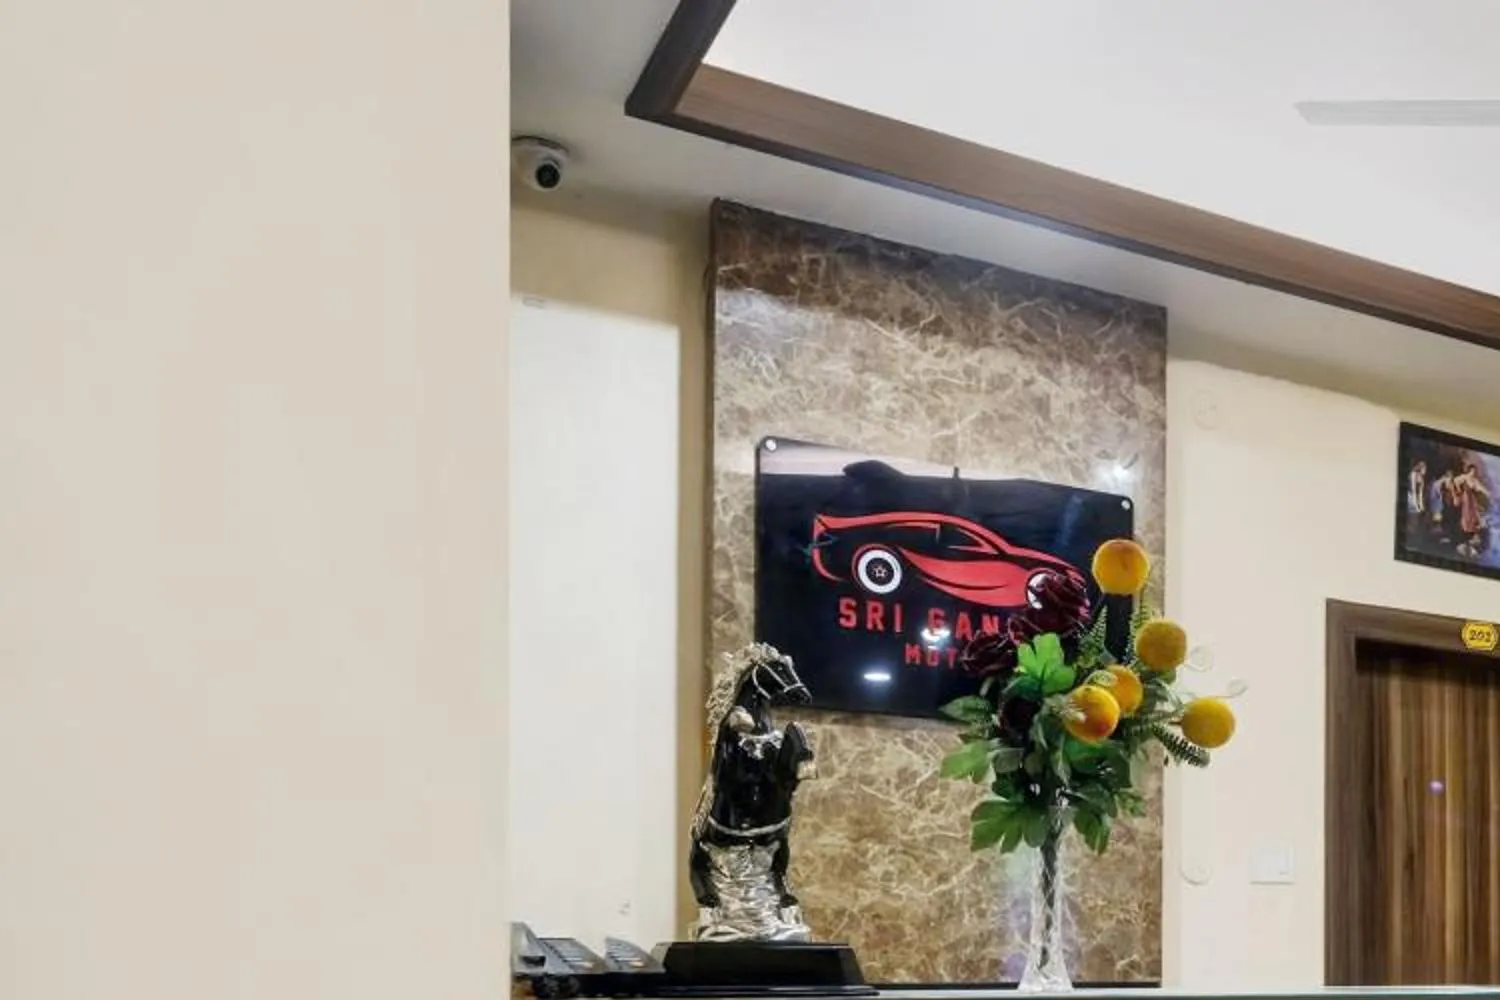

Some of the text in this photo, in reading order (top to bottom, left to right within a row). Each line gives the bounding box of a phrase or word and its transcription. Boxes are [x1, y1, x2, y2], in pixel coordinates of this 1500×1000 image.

[838, 597, 1000, 641] SRI GAN
[905, 643, 958, 668] MOT
